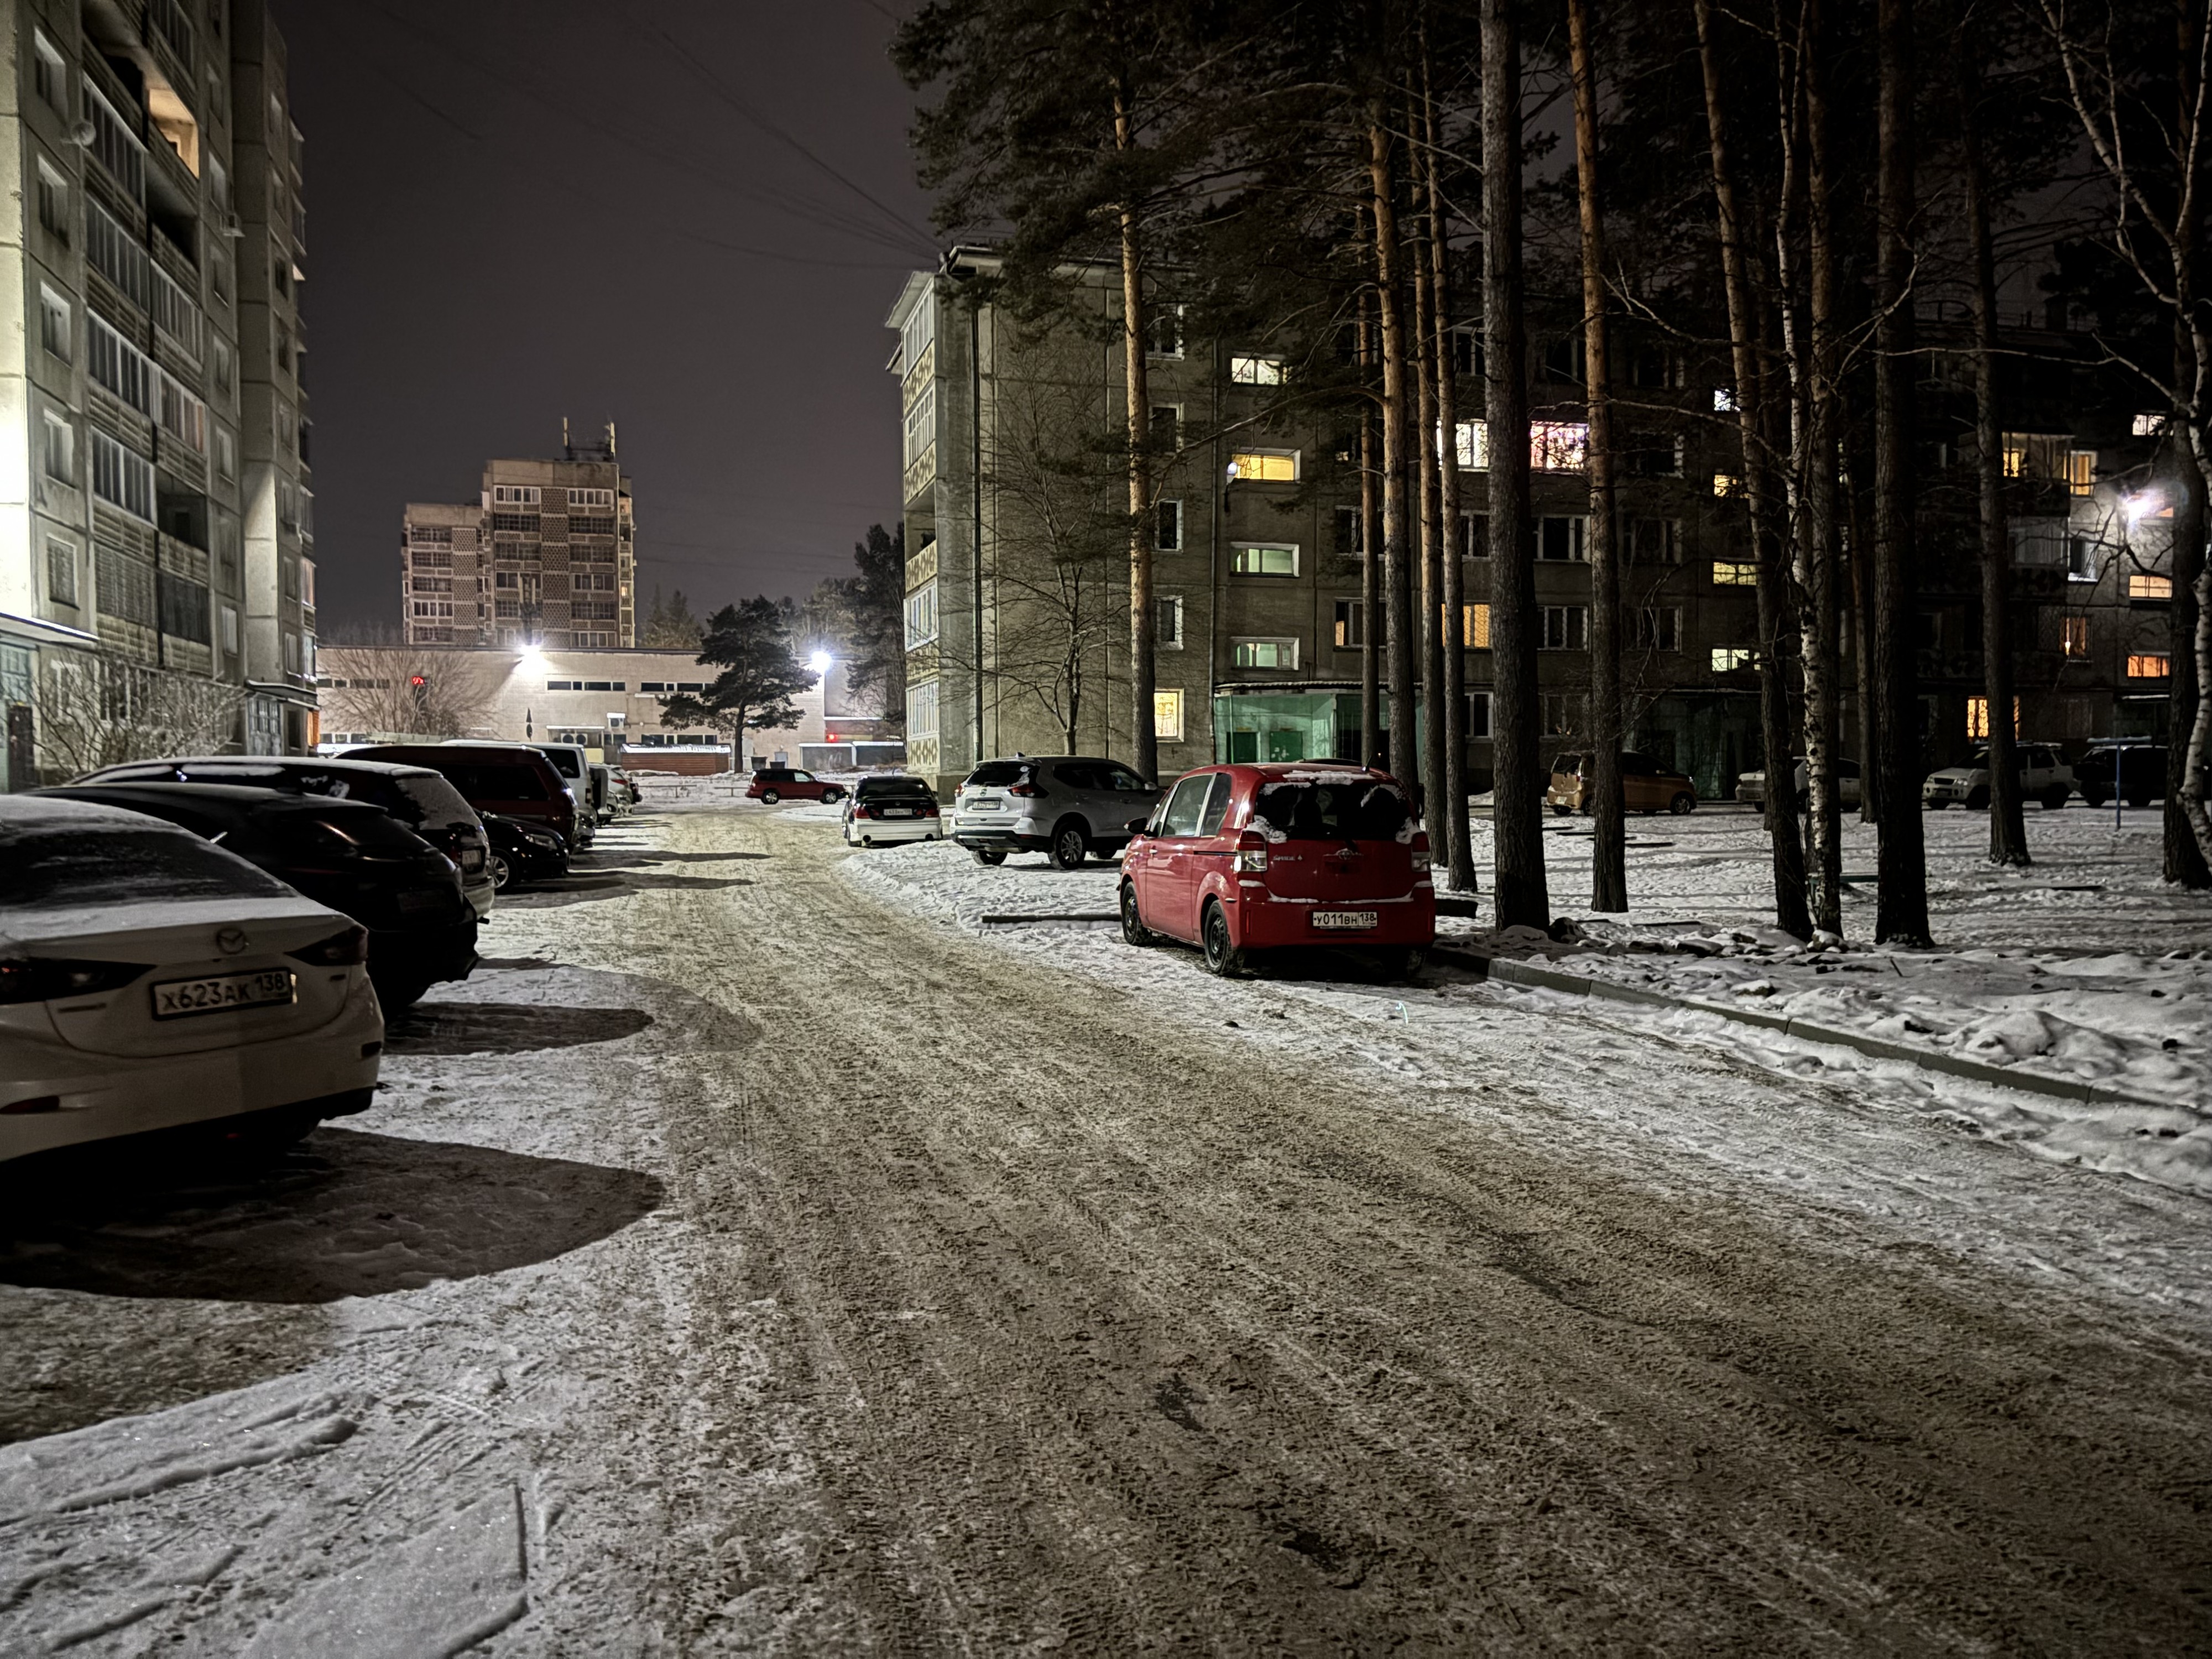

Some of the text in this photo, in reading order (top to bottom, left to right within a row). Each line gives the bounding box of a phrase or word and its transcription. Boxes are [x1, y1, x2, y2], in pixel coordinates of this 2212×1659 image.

[1316, 913, 1374, 925] У011ВН 138
[163, 973, 285, 1011] Х623АК 138
